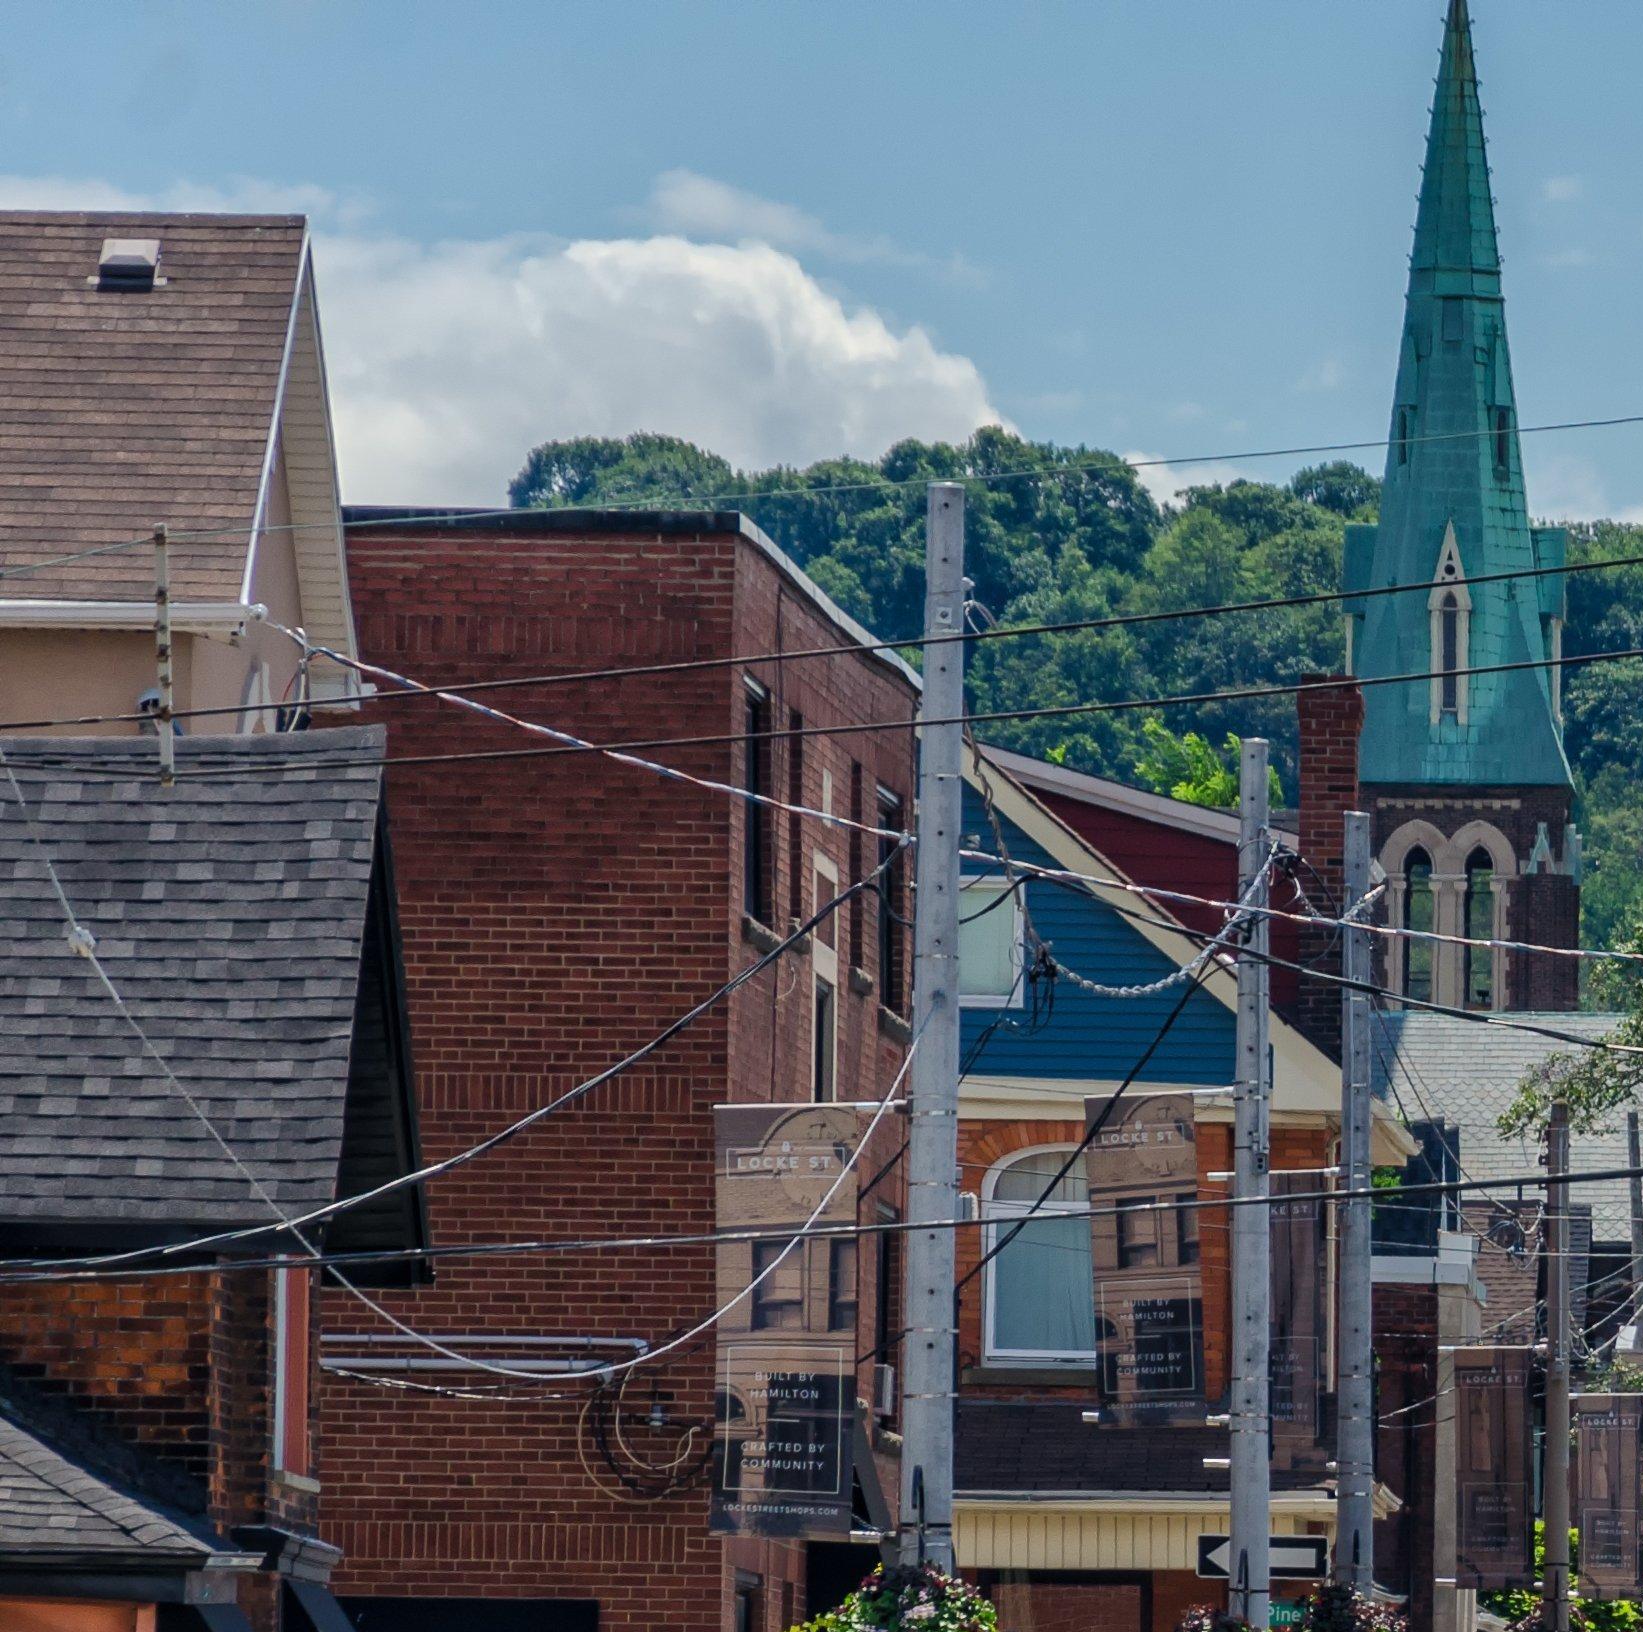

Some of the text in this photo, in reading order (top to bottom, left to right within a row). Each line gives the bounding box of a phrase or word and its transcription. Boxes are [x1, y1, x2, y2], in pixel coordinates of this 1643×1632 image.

[1101, 1131, 1149, 1144] LOCKE
[737, 1156, 800, 1170] LOCKE
[753, 1371, 816, 1382] BUILT BY
[749, 1388, 819, 1400] HAMILTON
[740, 1442, 826, 1454] CRAFTED BY
[740, 1458, 825, 1471] COMMUNITY
[1267, 1606, 1301, 1623] Pine
